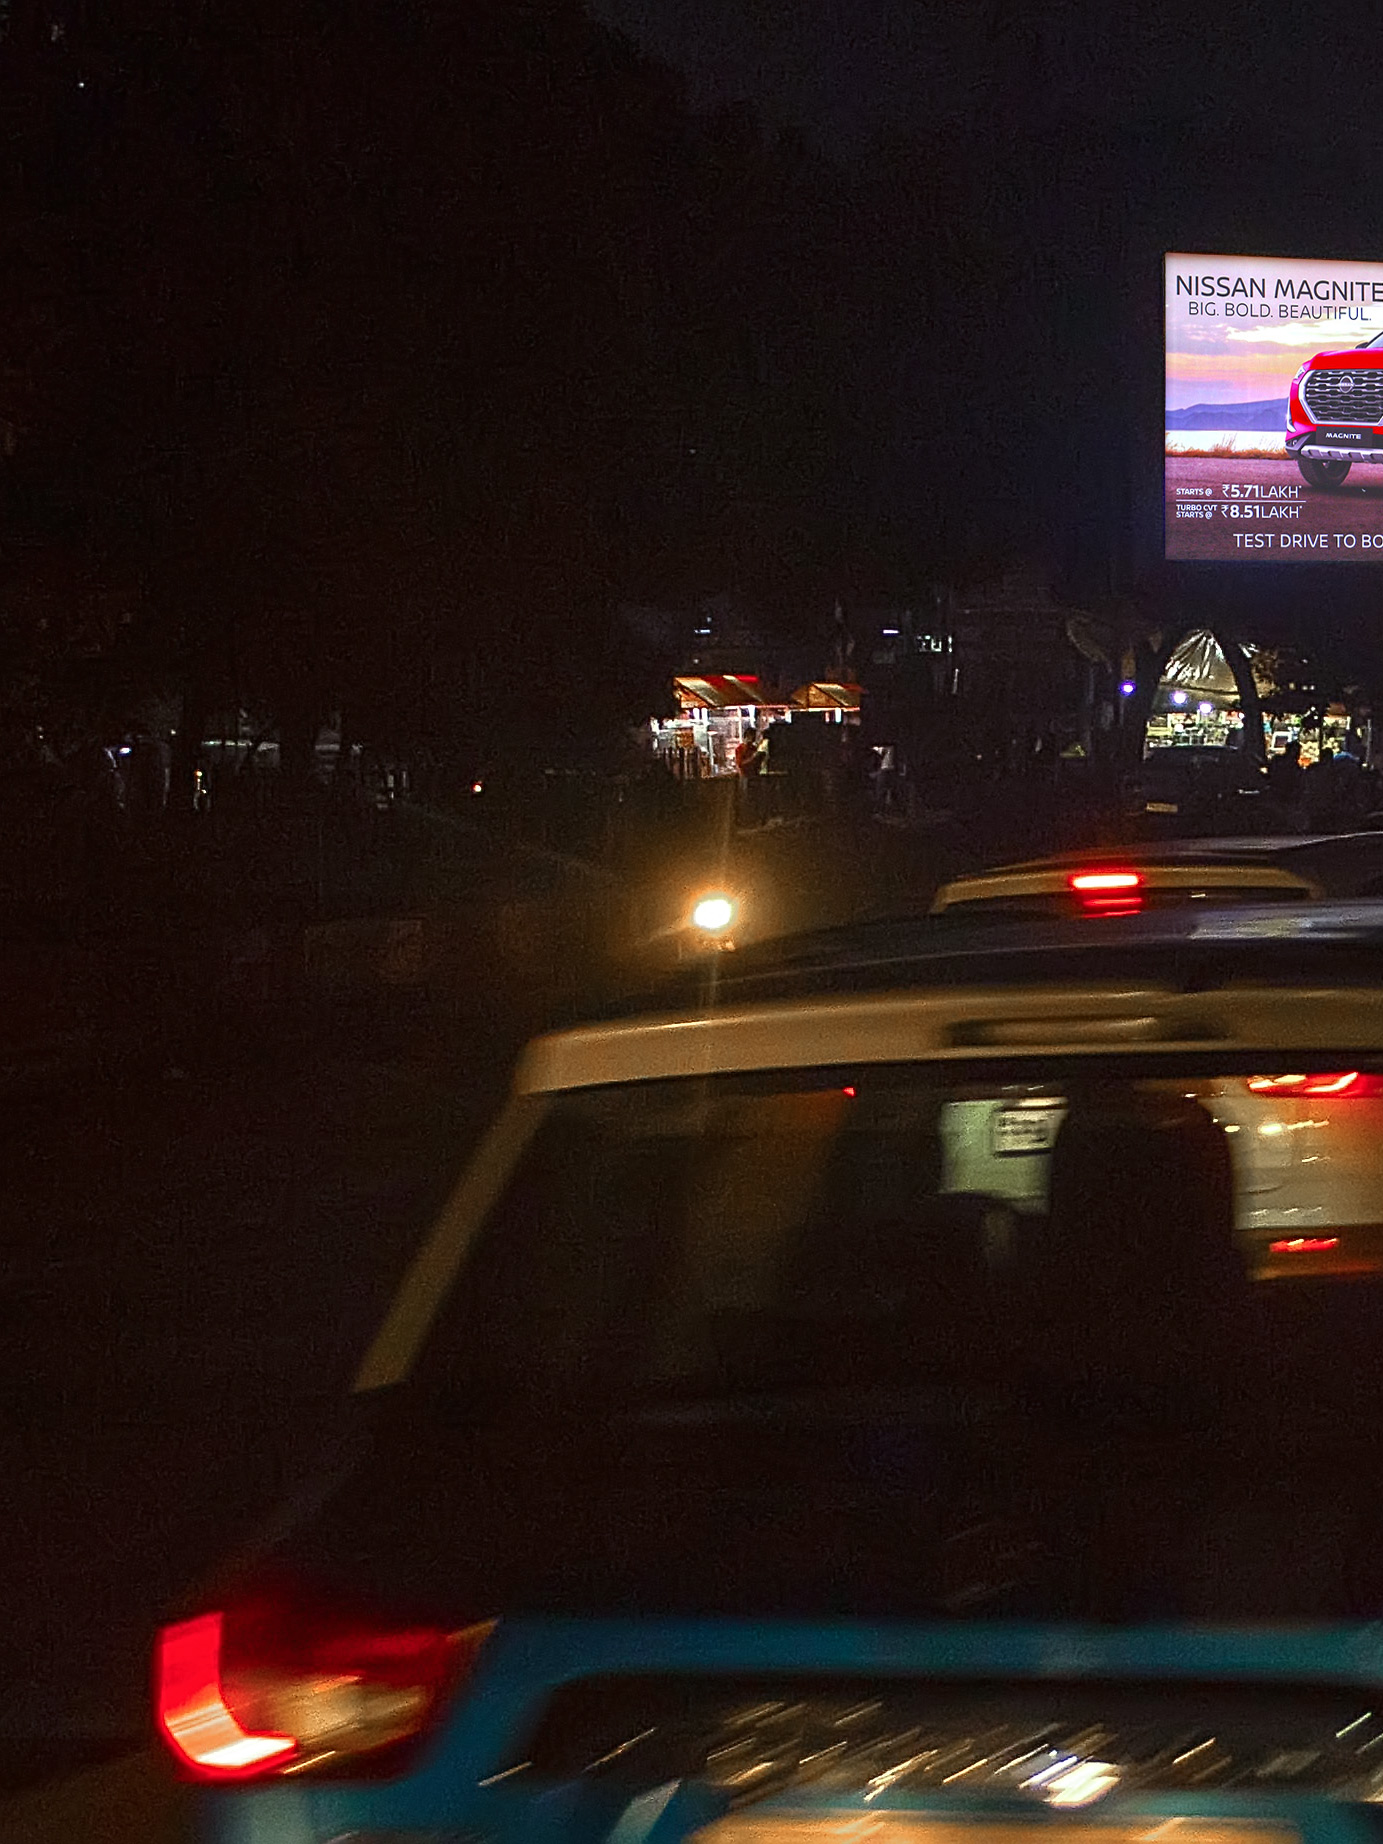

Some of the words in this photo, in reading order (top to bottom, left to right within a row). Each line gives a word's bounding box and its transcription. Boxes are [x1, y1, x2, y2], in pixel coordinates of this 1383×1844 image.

[1176, 275, 1266, 299] NISSAN
[1188, 301, 1220, 317] BIG.
[1225, 303, 1274, 319] BOLD.
[1278, 304, 1372, 321] BEAUTIFUL.
[1325, 432, 1362, 440] MAGNITE
[1176, 487, 1204, 496] STARTS
[1205, 487, 1213, 497] @
[1176, 511, 1204, 519] STARTS
[1205, 511, 1213, 520] @
[1233, 533, 1275, 548] TEST
[1280, 533, 1329, 548] DRIVE
[1333, 534, 1357, 549] TO
